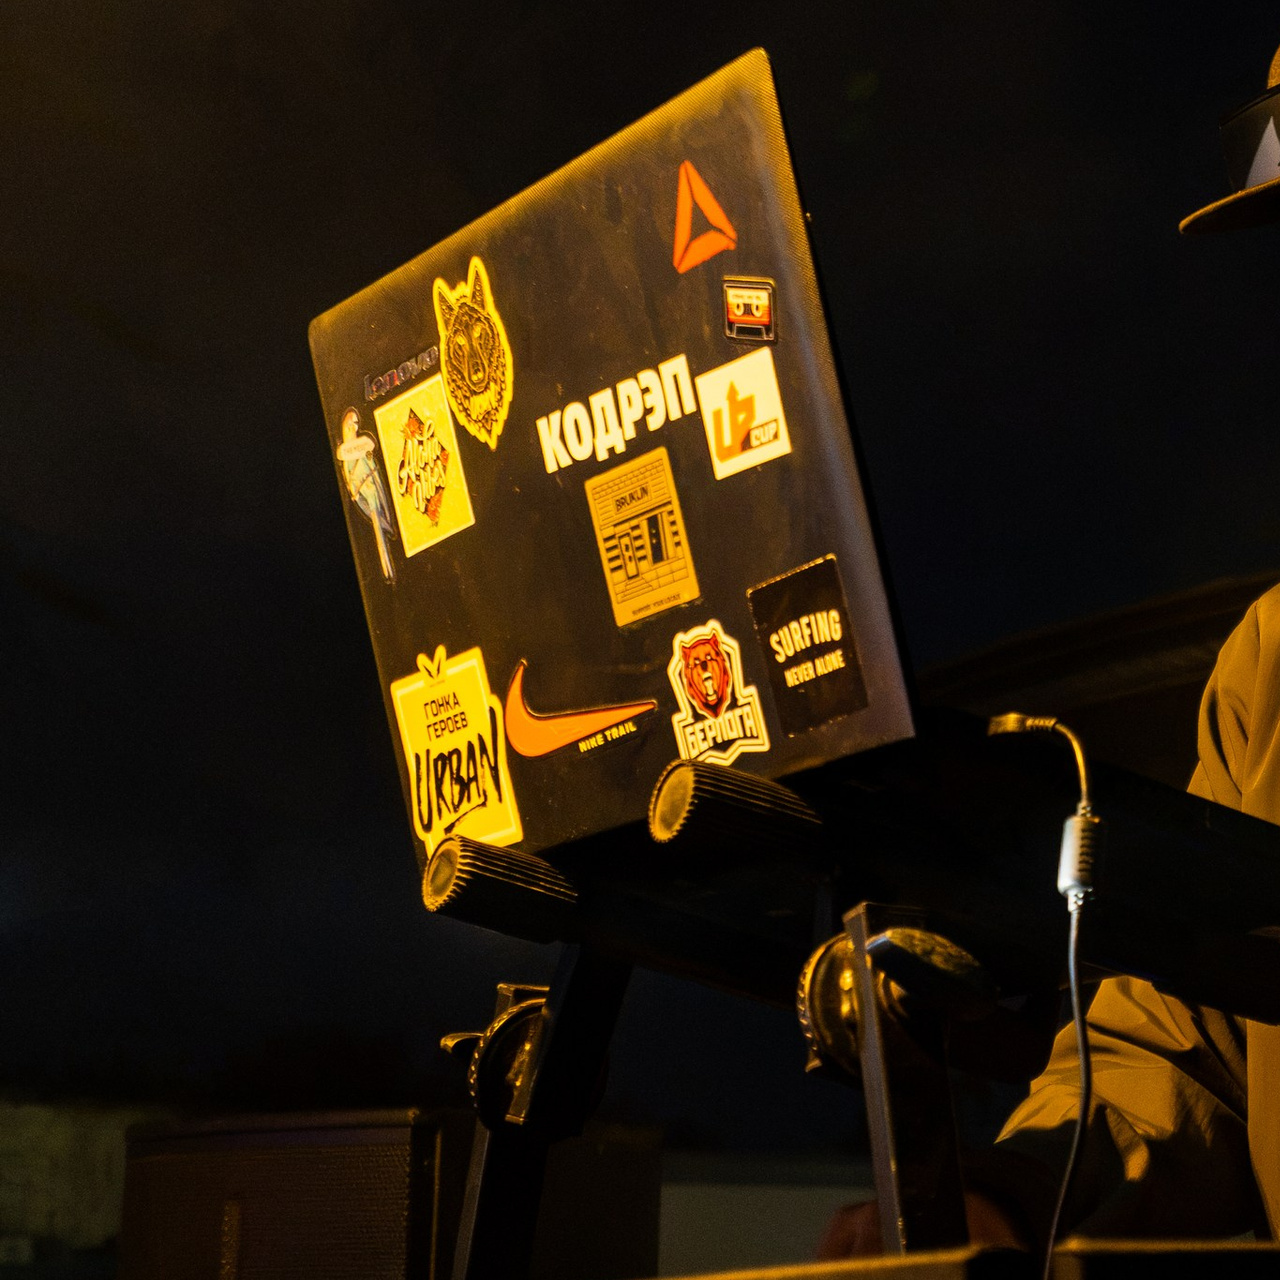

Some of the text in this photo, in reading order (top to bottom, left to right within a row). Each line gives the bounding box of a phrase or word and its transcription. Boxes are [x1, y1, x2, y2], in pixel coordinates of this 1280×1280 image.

[536, 353, 698, 473] КОДРЭП
[750, 420, 778, 448] CUP
[769, 608, 843, 663] SURFING
[783, 648, 846, 688] NEVER ALONE
[423, 691, 461, 720] ГОНКА
[426, 712, 469, 742] ГЕРОЕВ
[578, 721, 637, 753] NIKE TRAIL
[685, 704, 758, 760] БЕРЛОГА
[415, 705, 503, 835] URBAN
